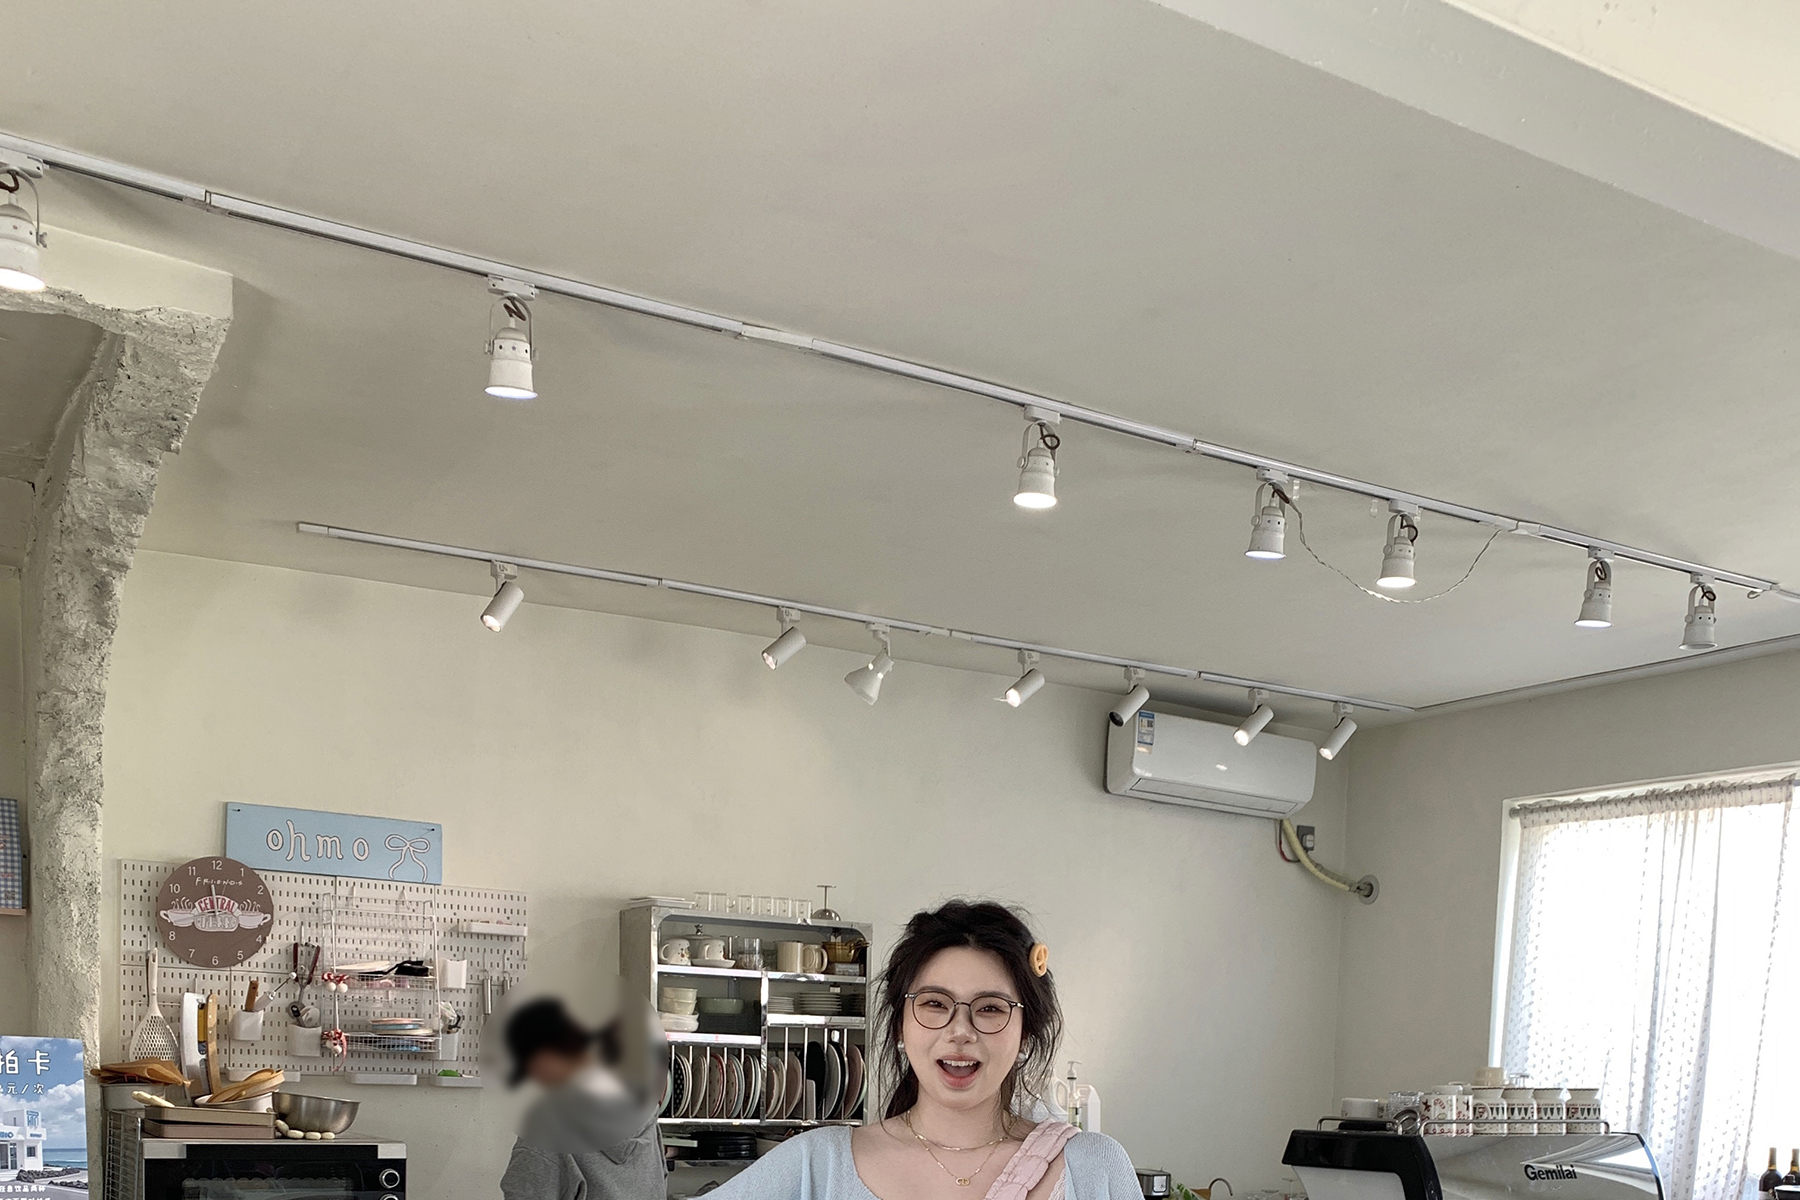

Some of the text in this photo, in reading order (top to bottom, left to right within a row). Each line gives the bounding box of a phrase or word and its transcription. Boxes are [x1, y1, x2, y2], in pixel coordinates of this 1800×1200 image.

[266, 819, 370, 862] ohmo
[211, 860, 222, 870] 12
[188, 866, 196, 876] 11
[169, 884, 180, 894] 10
[257, 886, 264, 895] 2
[197, 896, 236, 914] CENTRAL
[168, 931, 176, 941] 8
[255, 935, 262, 944] 4
[188, 949, 195, 958] 7
[237, 951, 244, 960] 5
[211, 956, 219, 965] 6
[1524, 1164, 1578, 1181] Gemilai
